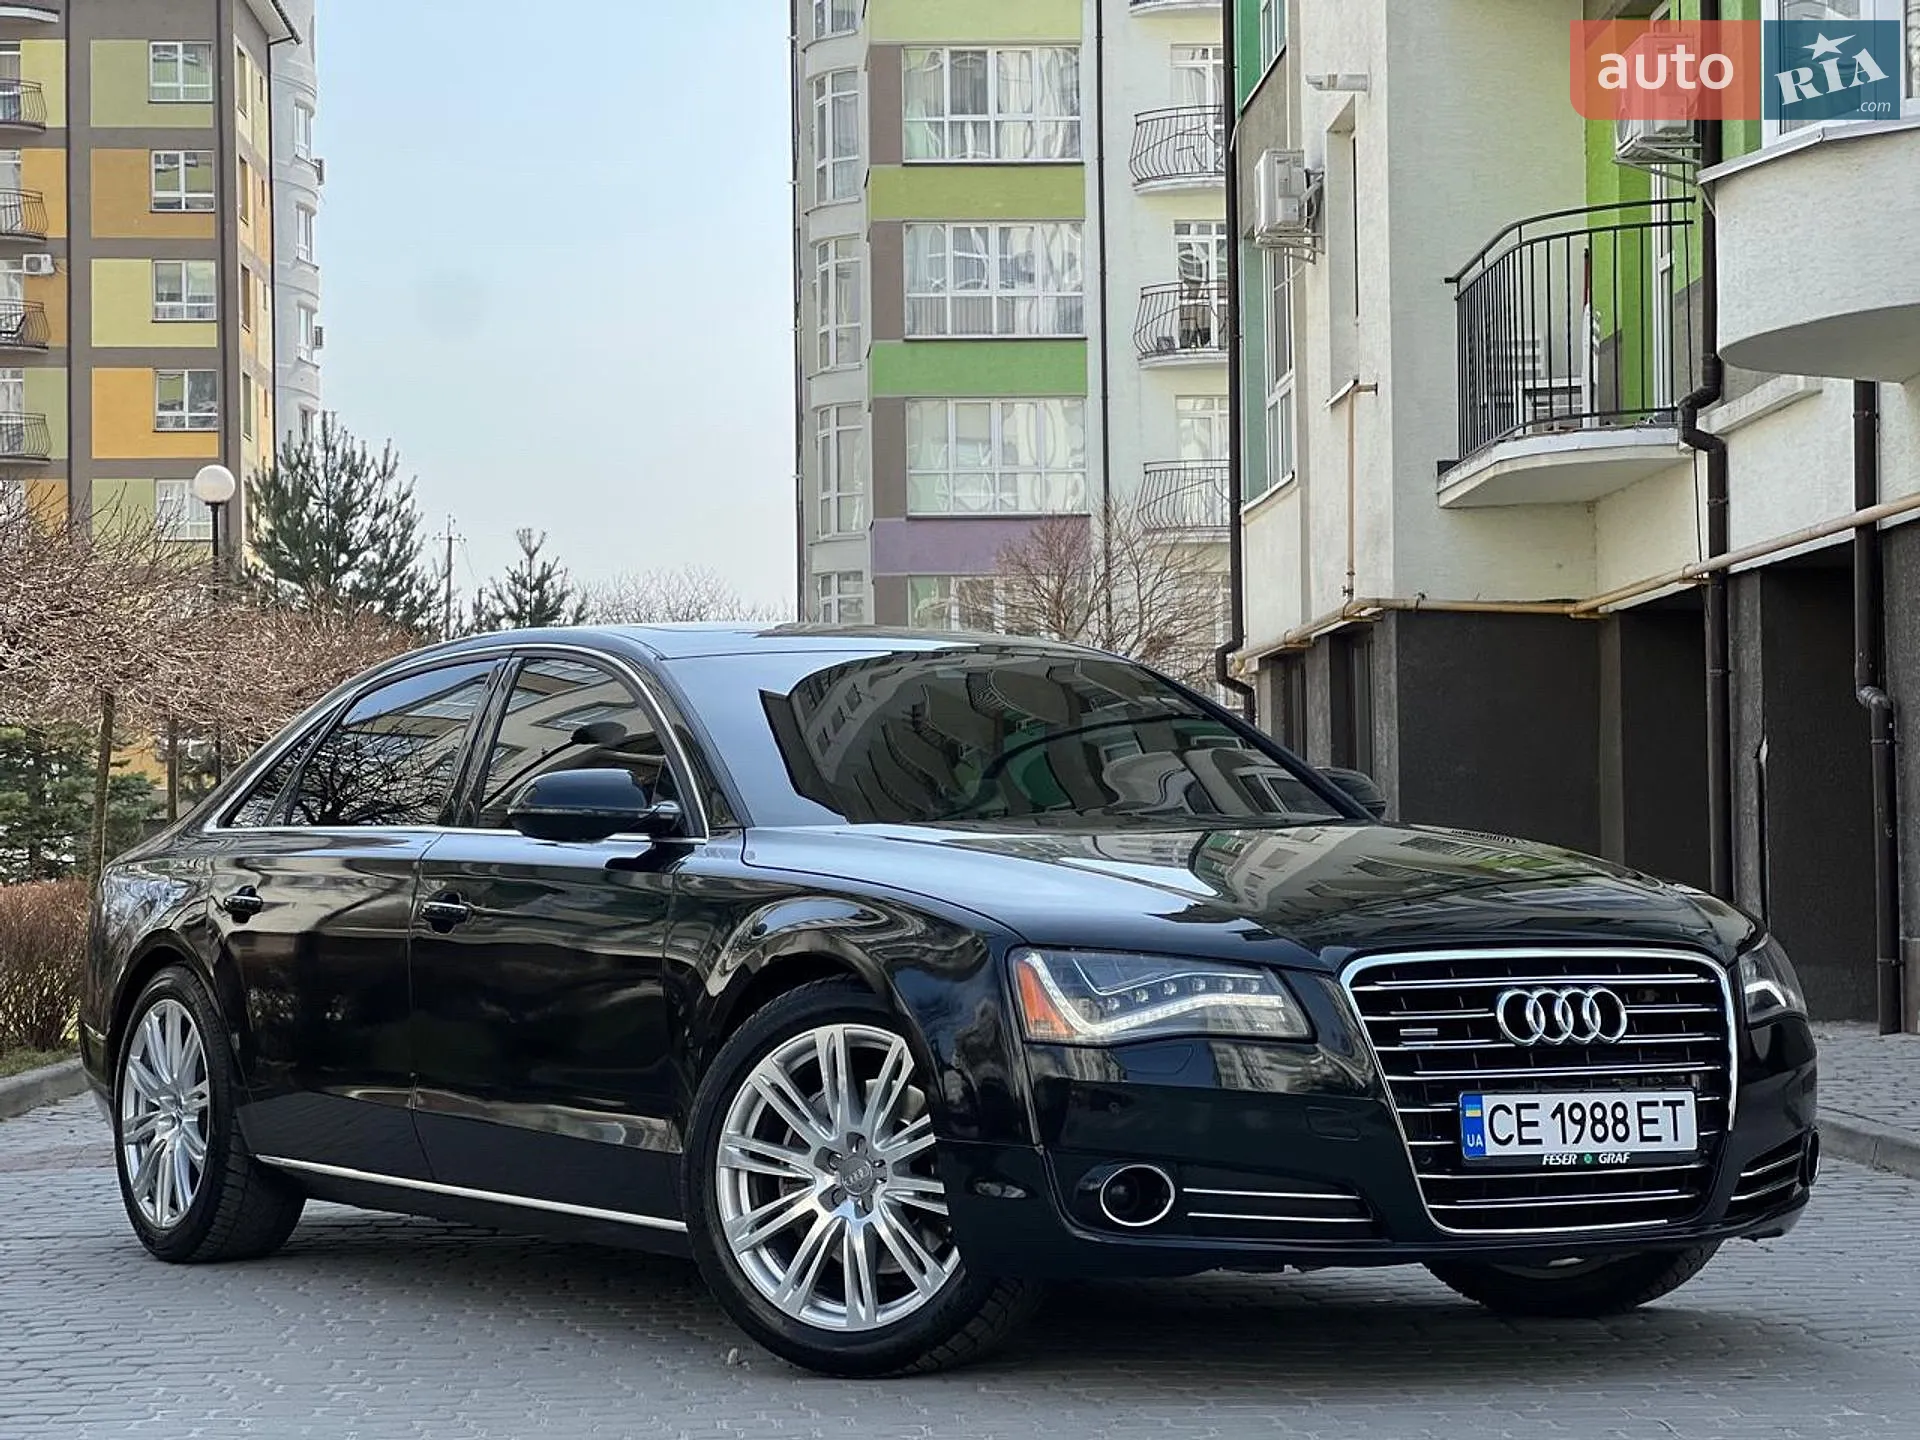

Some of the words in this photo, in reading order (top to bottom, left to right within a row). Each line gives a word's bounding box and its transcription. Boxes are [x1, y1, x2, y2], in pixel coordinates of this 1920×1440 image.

[1488, 1103, 1543, 1146] CE
[1550, 1101, 1629, 1145] 1988
[1636, 1100, 1686, 1142] ET
[1467, 1133, 1484, 1147] UA
[1542, 1153, 1578, 1165] FESER
[1599, 1152, 1631, 1164] GRAF
